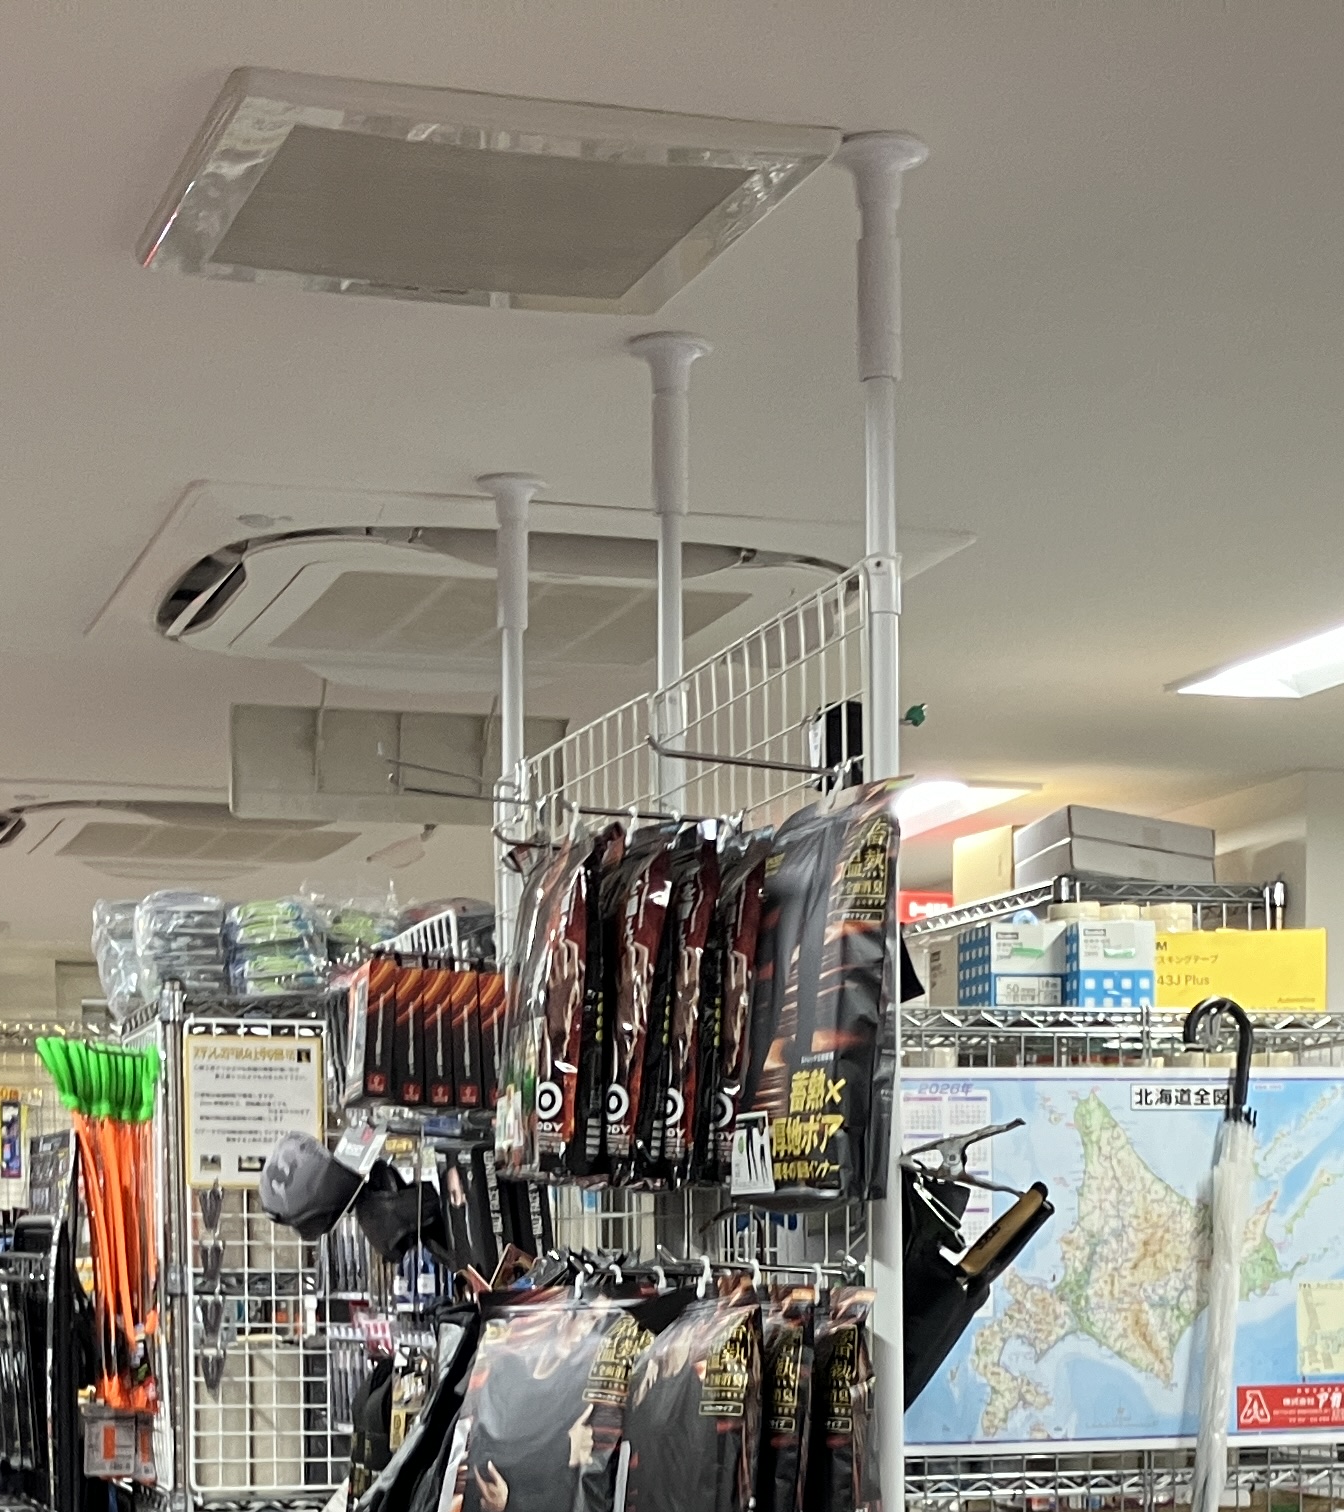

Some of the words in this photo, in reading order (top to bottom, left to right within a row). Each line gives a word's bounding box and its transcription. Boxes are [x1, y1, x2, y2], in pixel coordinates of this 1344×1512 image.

[1185, 974, 1210, 986] Plus
[1133, 1087, 1233, 1107] 北海道全図
